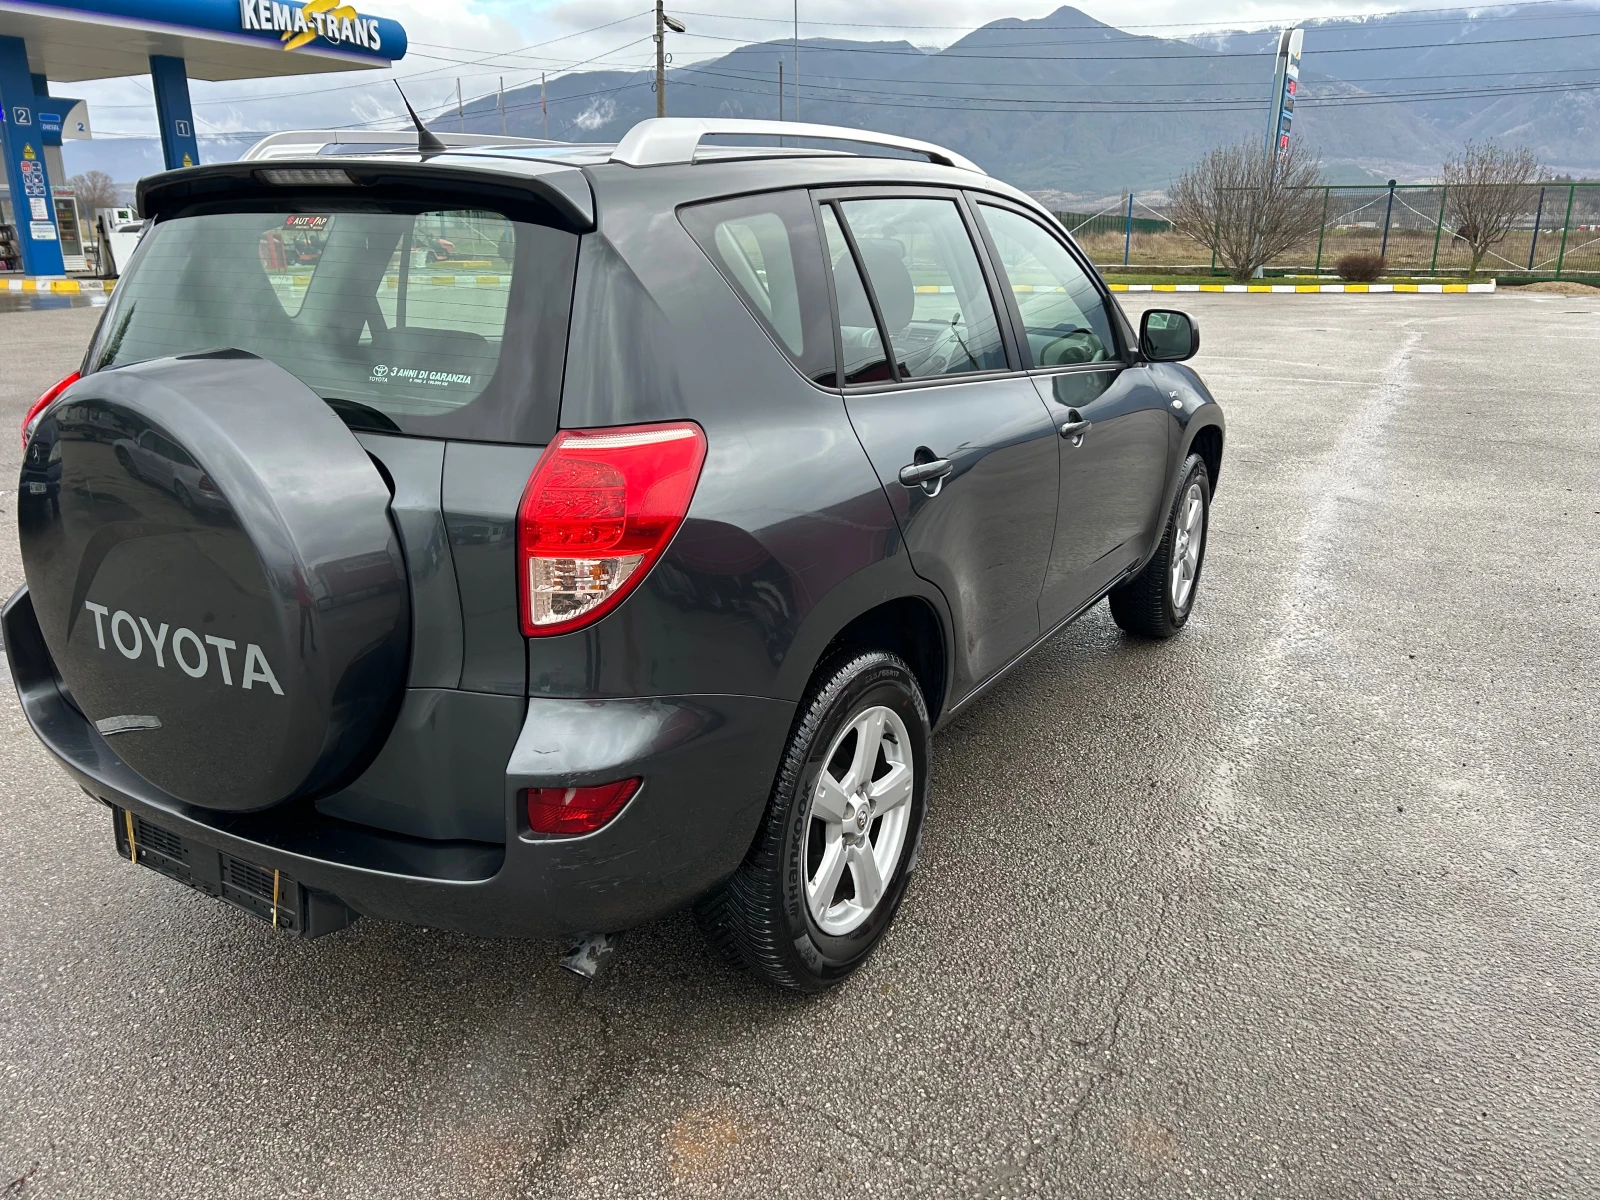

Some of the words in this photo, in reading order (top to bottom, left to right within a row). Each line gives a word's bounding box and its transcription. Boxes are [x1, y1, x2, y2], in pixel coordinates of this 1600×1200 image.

[240, 0, 382, 51] KEMA-TRANS
[18, 110, 27, 123] 2
[77, 123, 85, 132] 2
[179, 123, 185, 135] 1
[390, 367, 398, 376] 3
[397, 368, 418, 378] ANNI
[418, 370, 429, 379] DI
[429, 371, 472, 384] GARANZIA
[85, 600, 285, 696] TOYOTA
